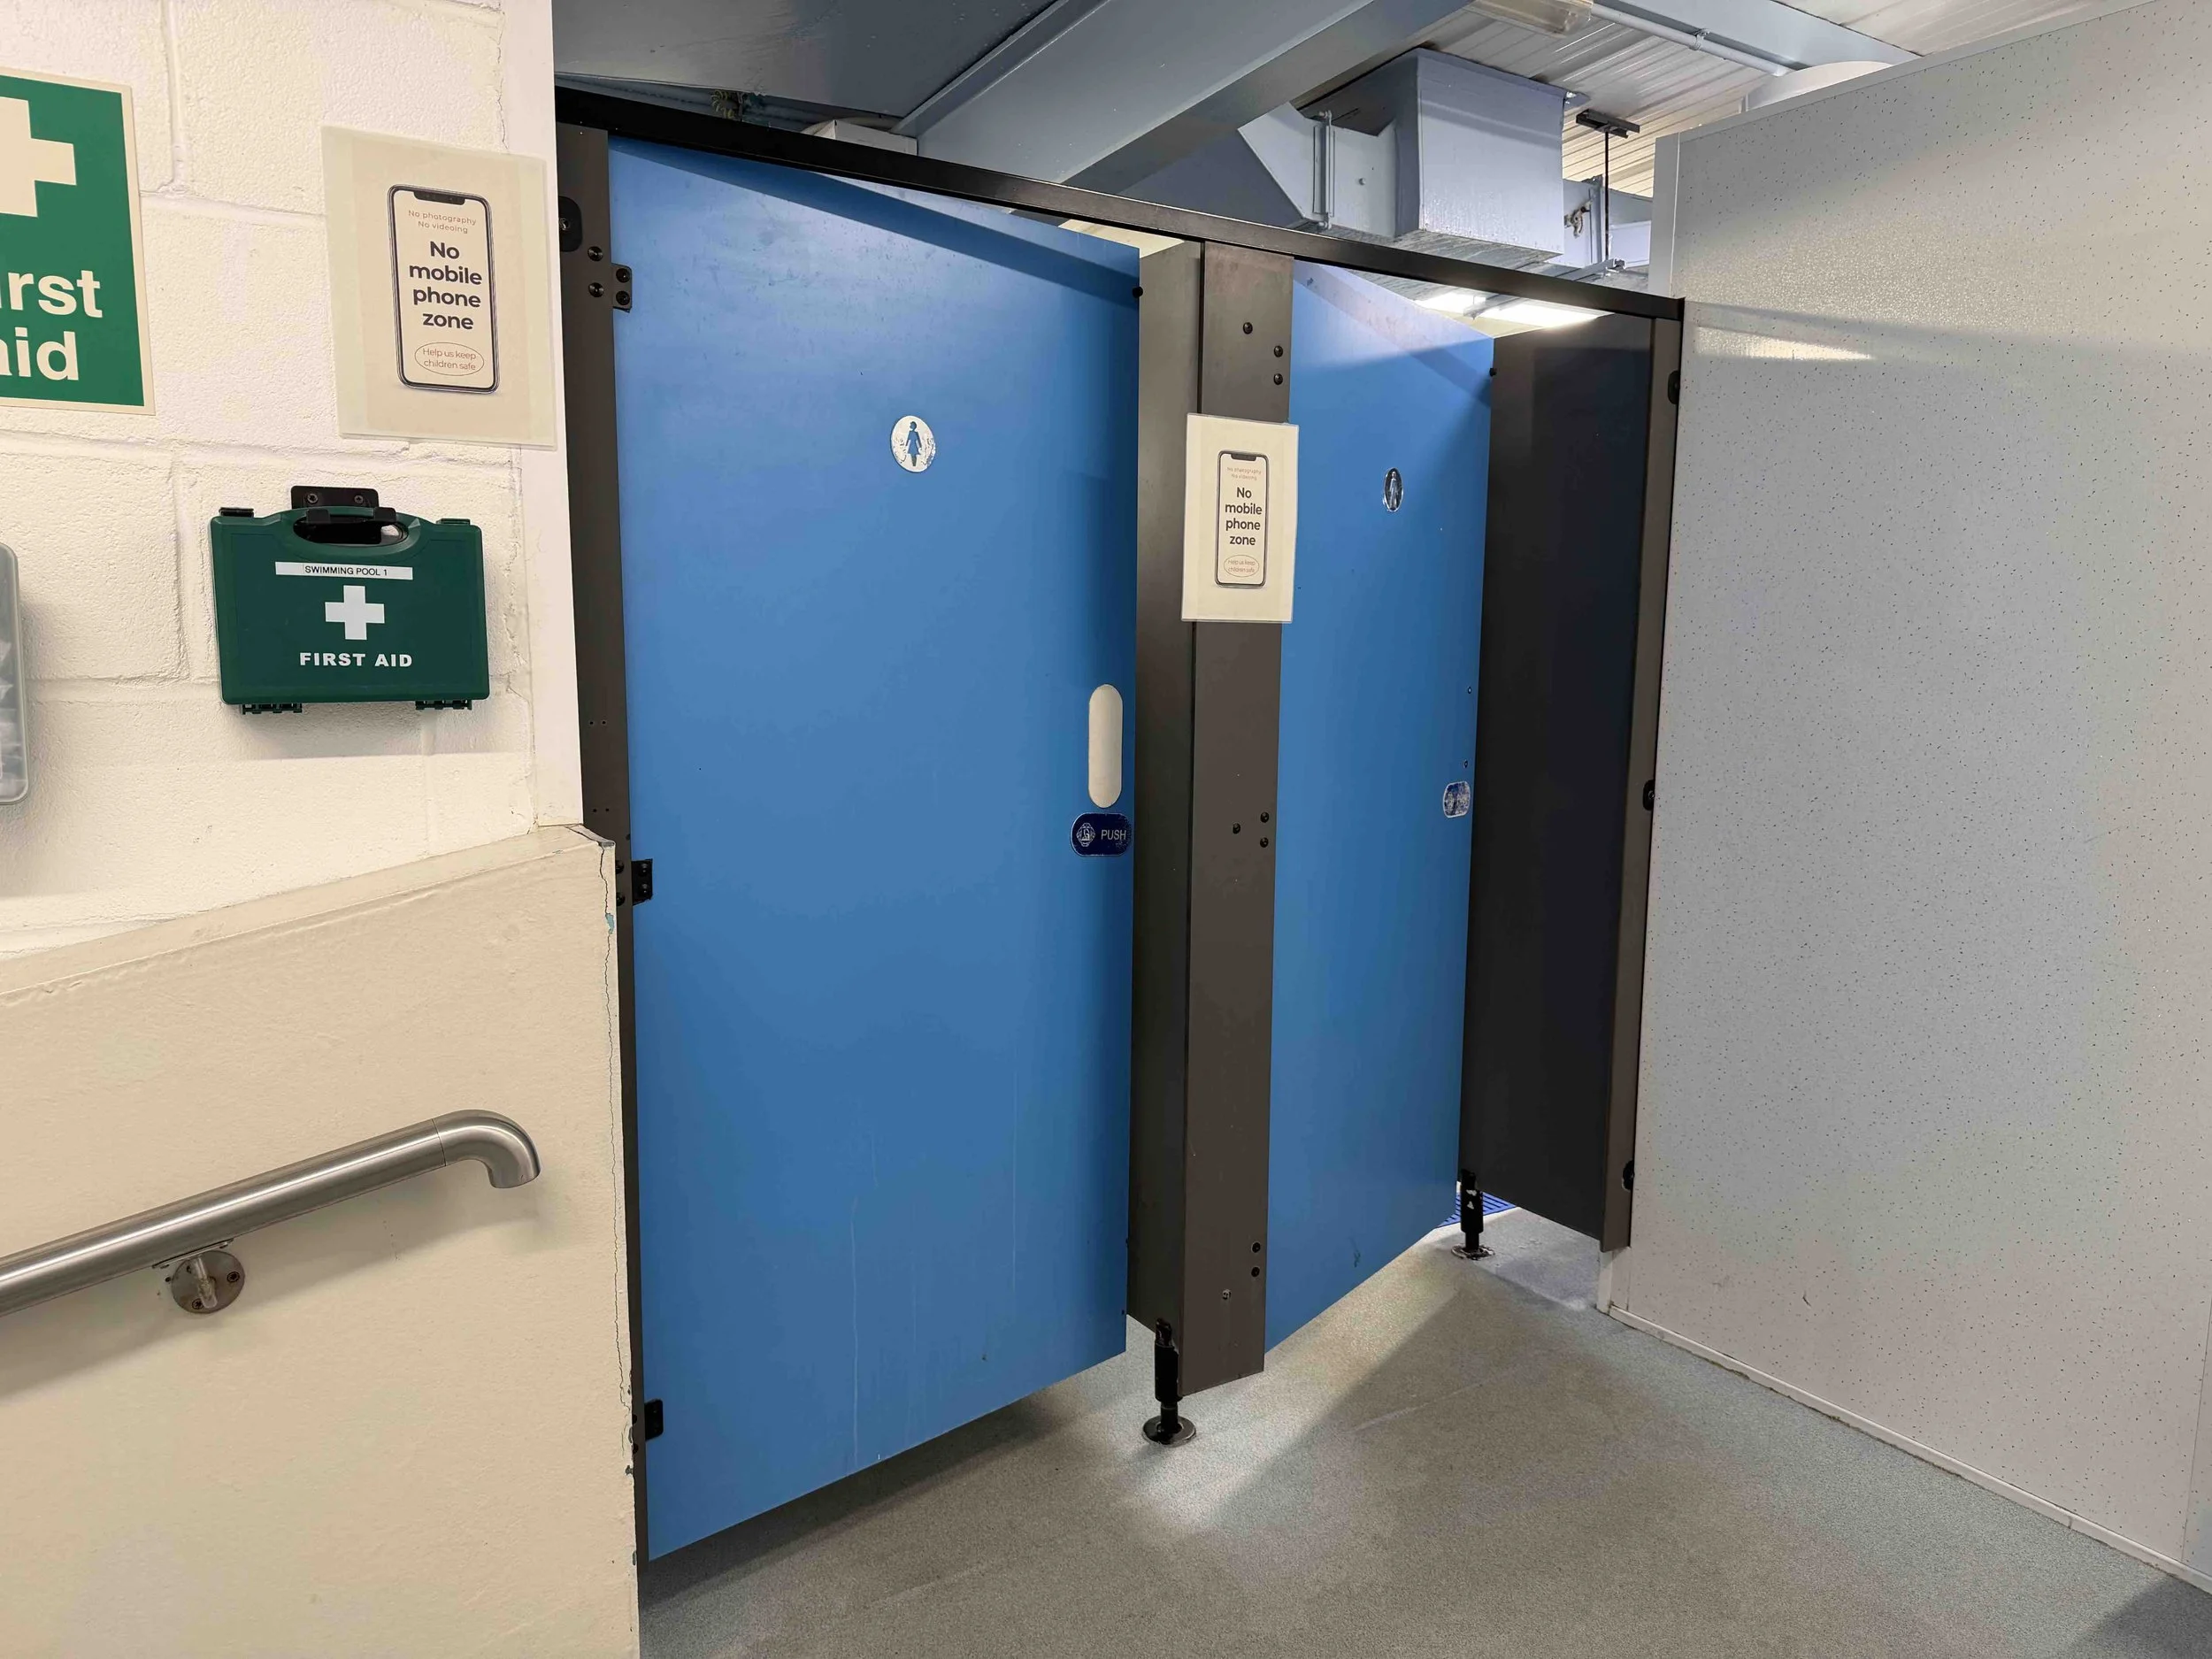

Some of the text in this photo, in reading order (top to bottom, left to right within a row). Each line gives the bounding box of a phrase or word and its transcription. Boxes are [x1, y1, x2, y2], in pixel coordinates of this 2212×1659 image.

[408, 209, 477, 226] No photography
[432, 223, 468, 234] videoing
[430, 241, 460, 259] No
[409, 265, 482, 285] mobile
[0, 270, 103, 318] rst
[413, 287, 481, 308] phone
[422, 313, 474, 330] zone
[422, 348, 442, 358] Help
[455, 350, 477, 361] keep
[423, 359, 476, 371] children safe
[1236, 487, 1252, 499] No
[1225, 503, 1263, 515] mobile
[1225, 518, 1261, 531] phone
[1229, 535, 1256, 546] zone
[304, 565, 354, 575] SWIMMING
[299, 652, 412, 667] FIRST AID
[1101, 829, 1126, 841] PUSH
